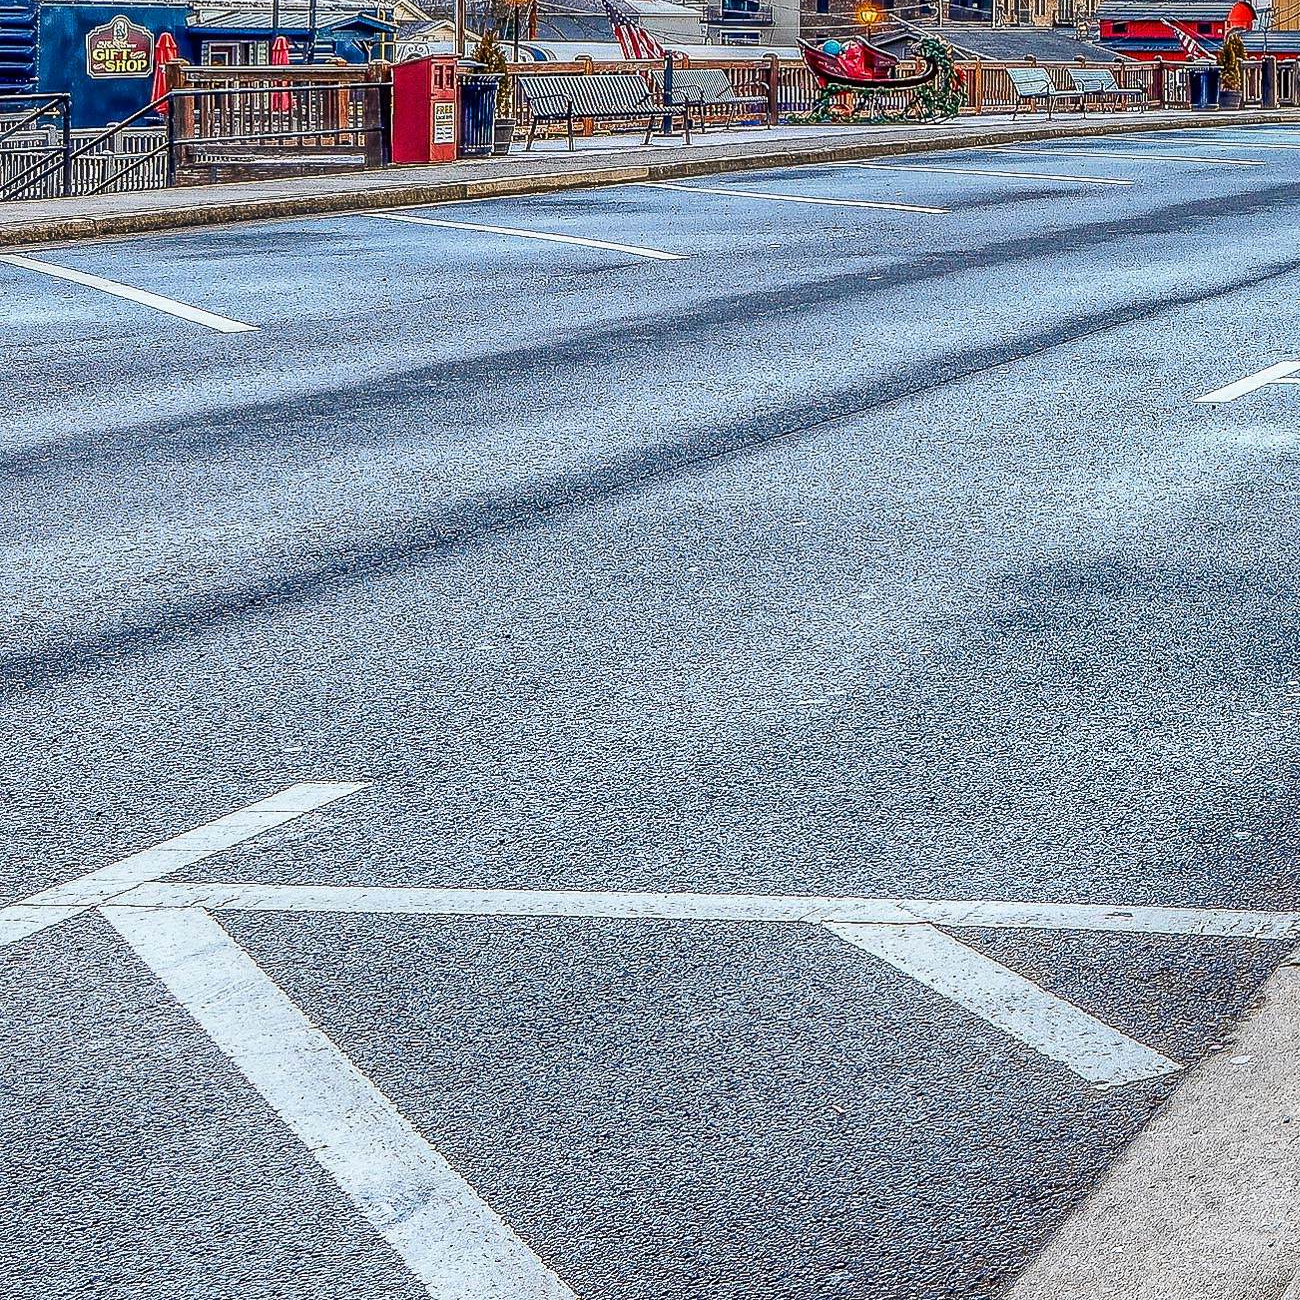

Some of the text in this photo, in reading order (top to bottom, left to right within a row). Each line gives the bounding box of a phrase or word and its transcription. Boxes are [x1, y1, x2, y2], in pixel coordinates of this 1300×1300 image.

[92, 48, 132, 61] GIFT
[105, 59, 148, 72] SHOP
[435, 104, 453, 114] FREE
